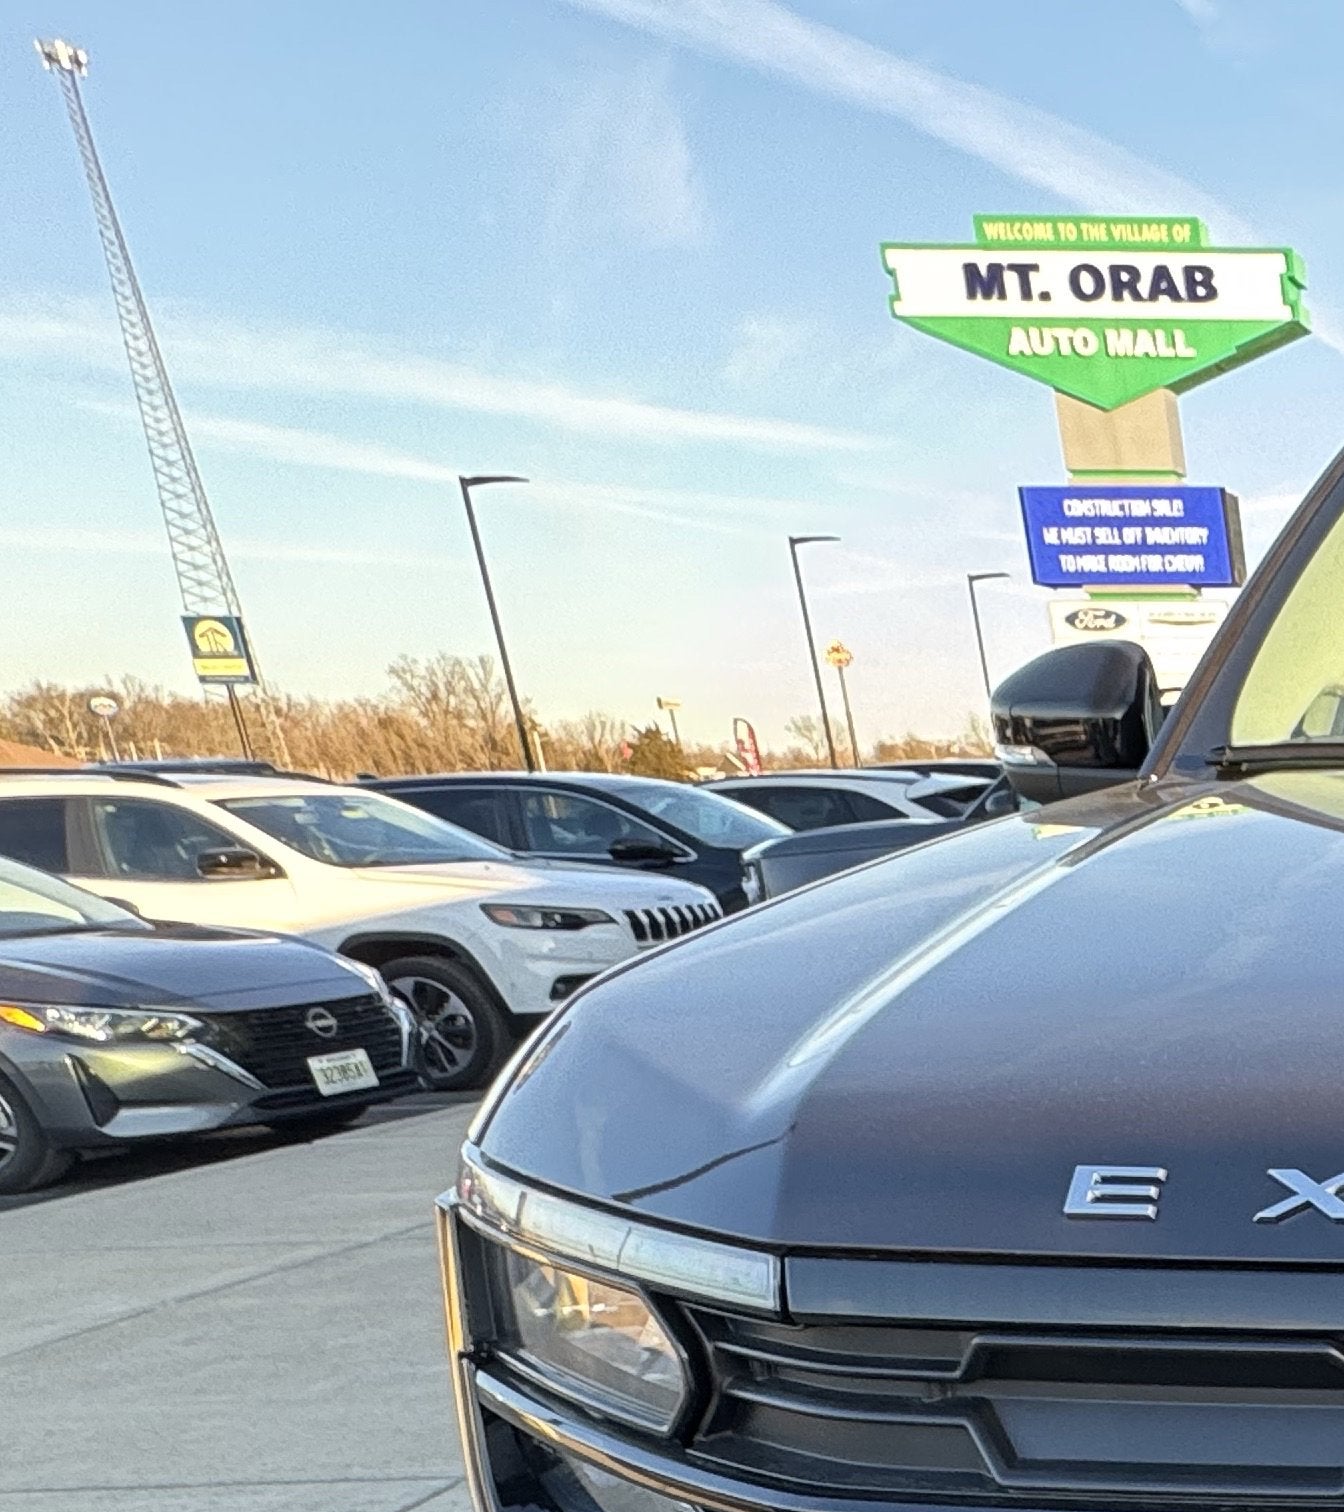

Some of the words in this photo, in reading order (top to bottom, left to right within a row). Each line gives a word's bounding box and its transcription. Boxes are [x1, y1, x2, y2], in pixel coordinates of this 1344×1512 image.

[982, 222, 1055, 241] WELCOME
[1057, 223, 1077, 241] TO
[1079, 222, 1108, 242] THE
[1110, 223, 1169, 242] VILLAGE
[1172, 223, 1192, 243] OF
[962, 262, 1051, 301] MT.
[1068, 263, 1218, 303] ORAB
[1008, 326, 1099, 356] AUTO
[1103, 327, 1197, 358] MALL
[1042, 527, 1060, 545] WE
[1061, 527, 1092, 545] MUST
[1094, 527, 1121, 545] SELL
[1059, 555, 1076, 573] TO
[1077, 555, 1107, 573] MAKE
[1108, 555, 1139, 573] ROOM
[1075, 610, 1117, 630] Ford
